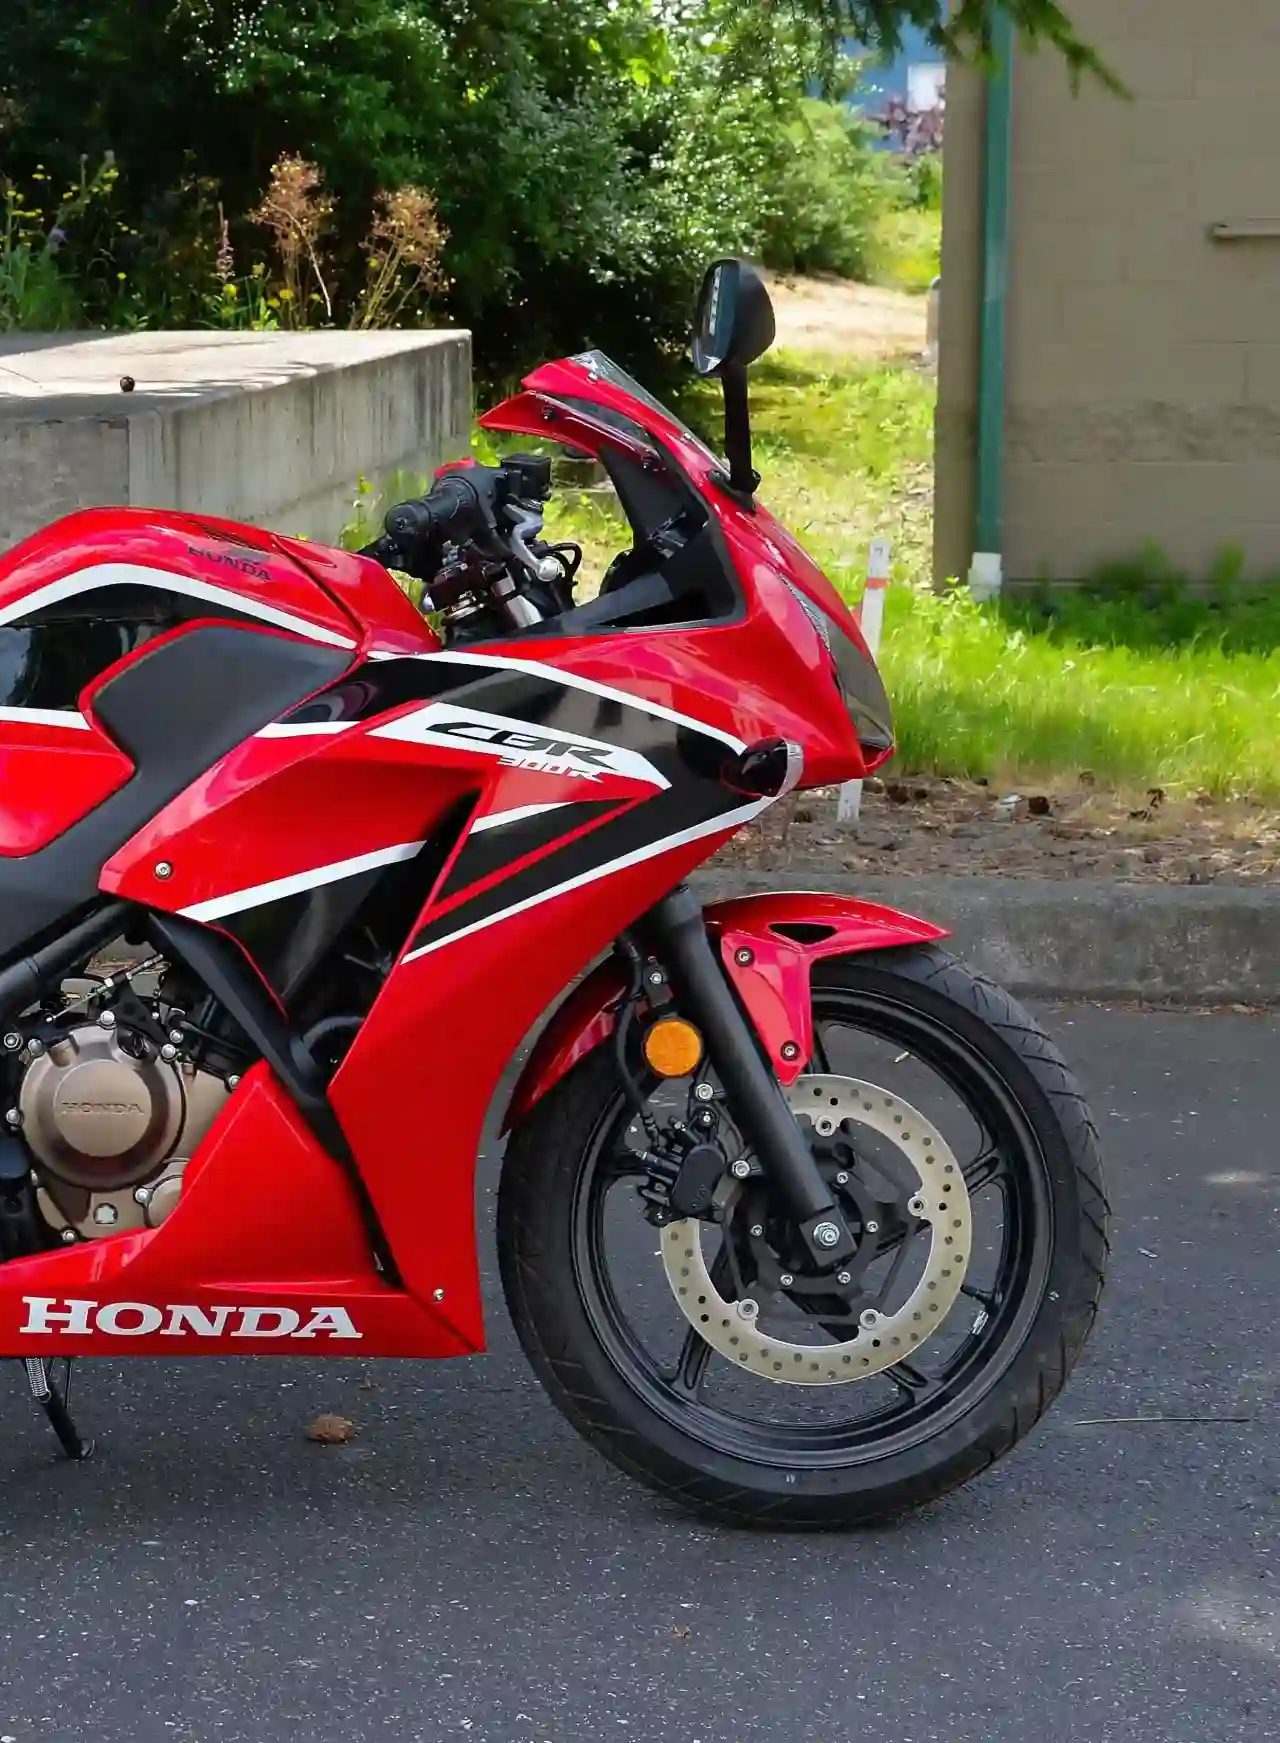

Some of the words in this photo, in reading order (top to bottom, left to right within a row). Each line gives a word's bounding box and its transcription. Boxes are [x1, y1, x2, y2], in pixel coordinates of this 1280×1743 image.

[426, 721, 619, 772] CBR
[496, 756, 604, 783] 300R
[61, 1102, 145, 1116] HONDA
[20, 1296, 363, 1339] HONDA
